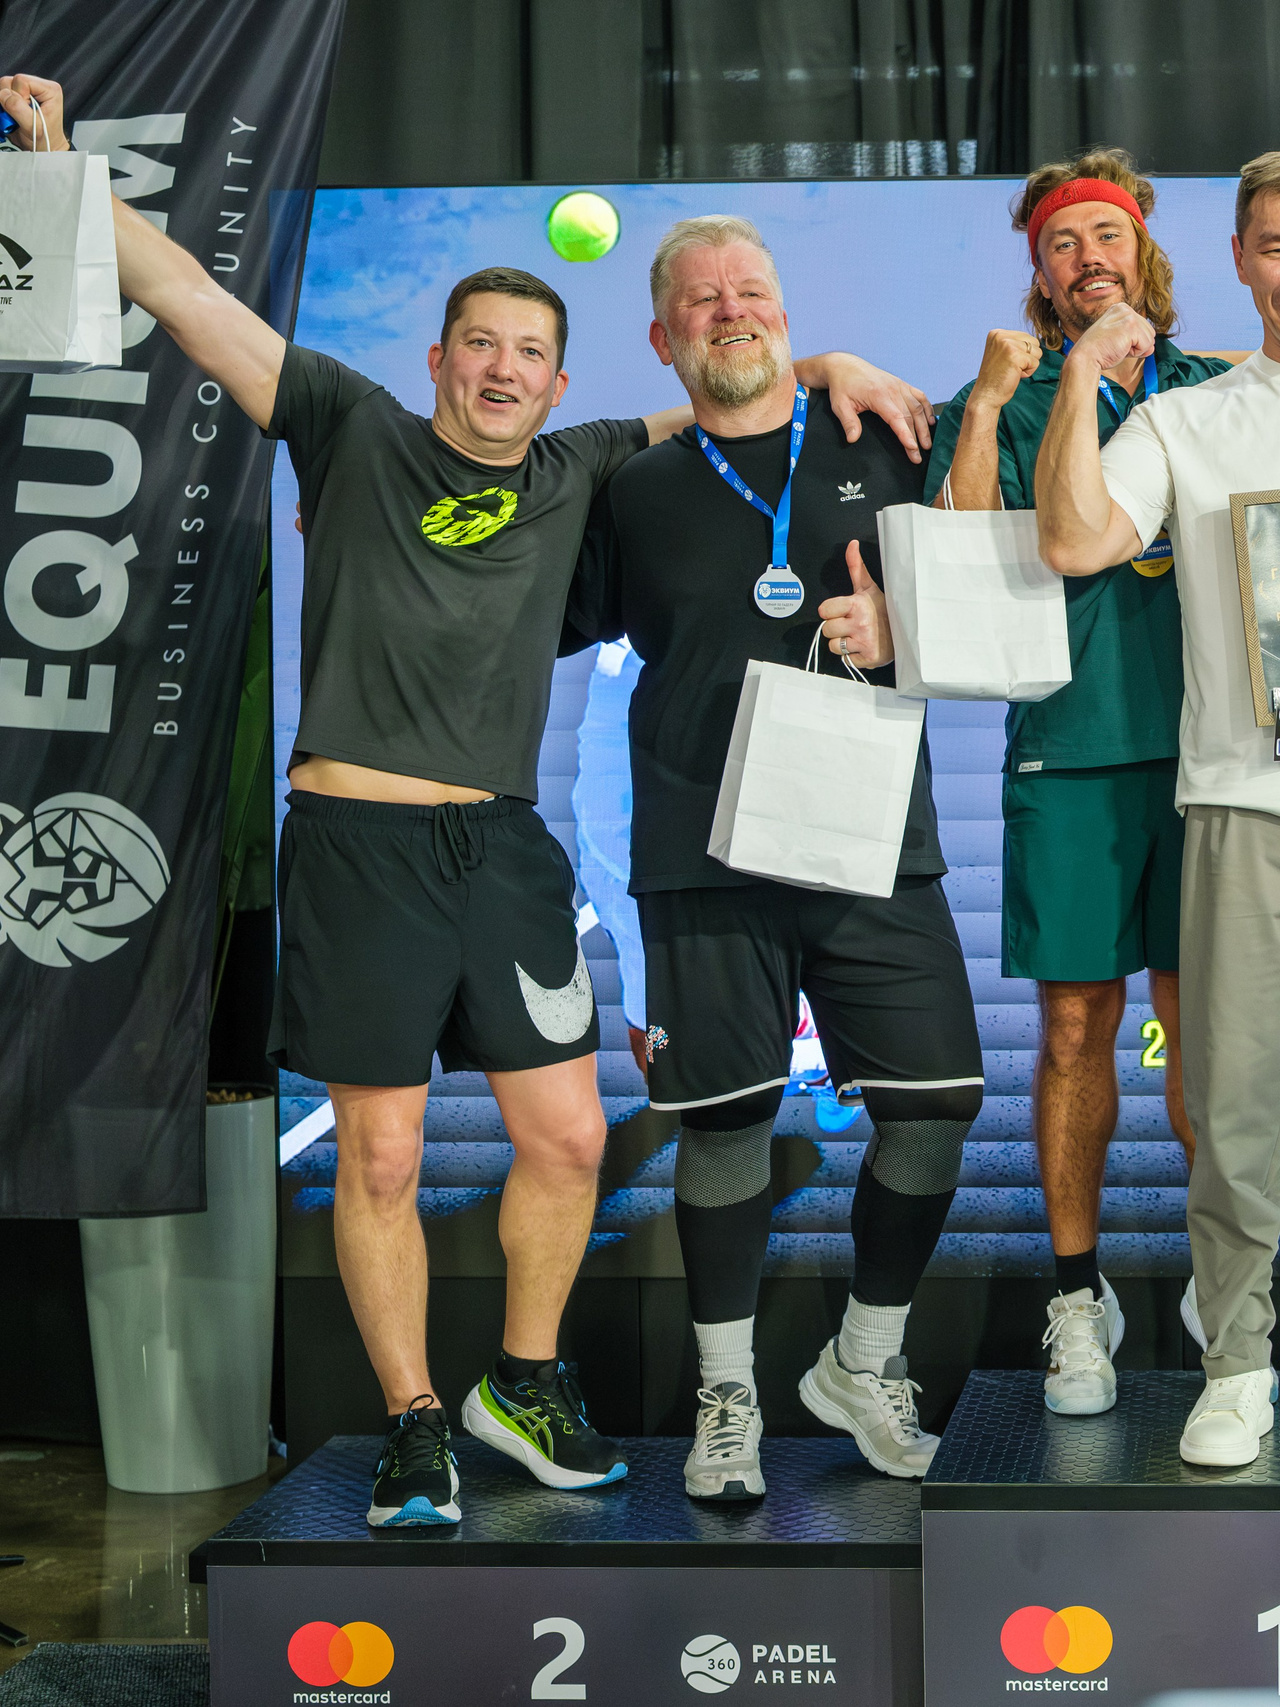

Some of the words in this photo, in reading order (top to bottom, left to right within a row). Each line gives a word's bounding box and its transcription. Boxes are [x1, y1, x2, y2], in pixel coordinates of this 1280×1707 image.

[153, 484, 210, 736] BUSINESS
[192, 116, 257, 443] COUNITY
[840, 493, 865, 501] adidas
[530, 1617, 587, 1700] 2
[752, 1644, 836, 1662] PADEL
[707, 1658, 735, 1670] 360
[754, 1669, 836, 1684] ARENA
[1005, 1677, 1108, 1692] mastercard
[293, 1690, 390, 1704] mastercard
